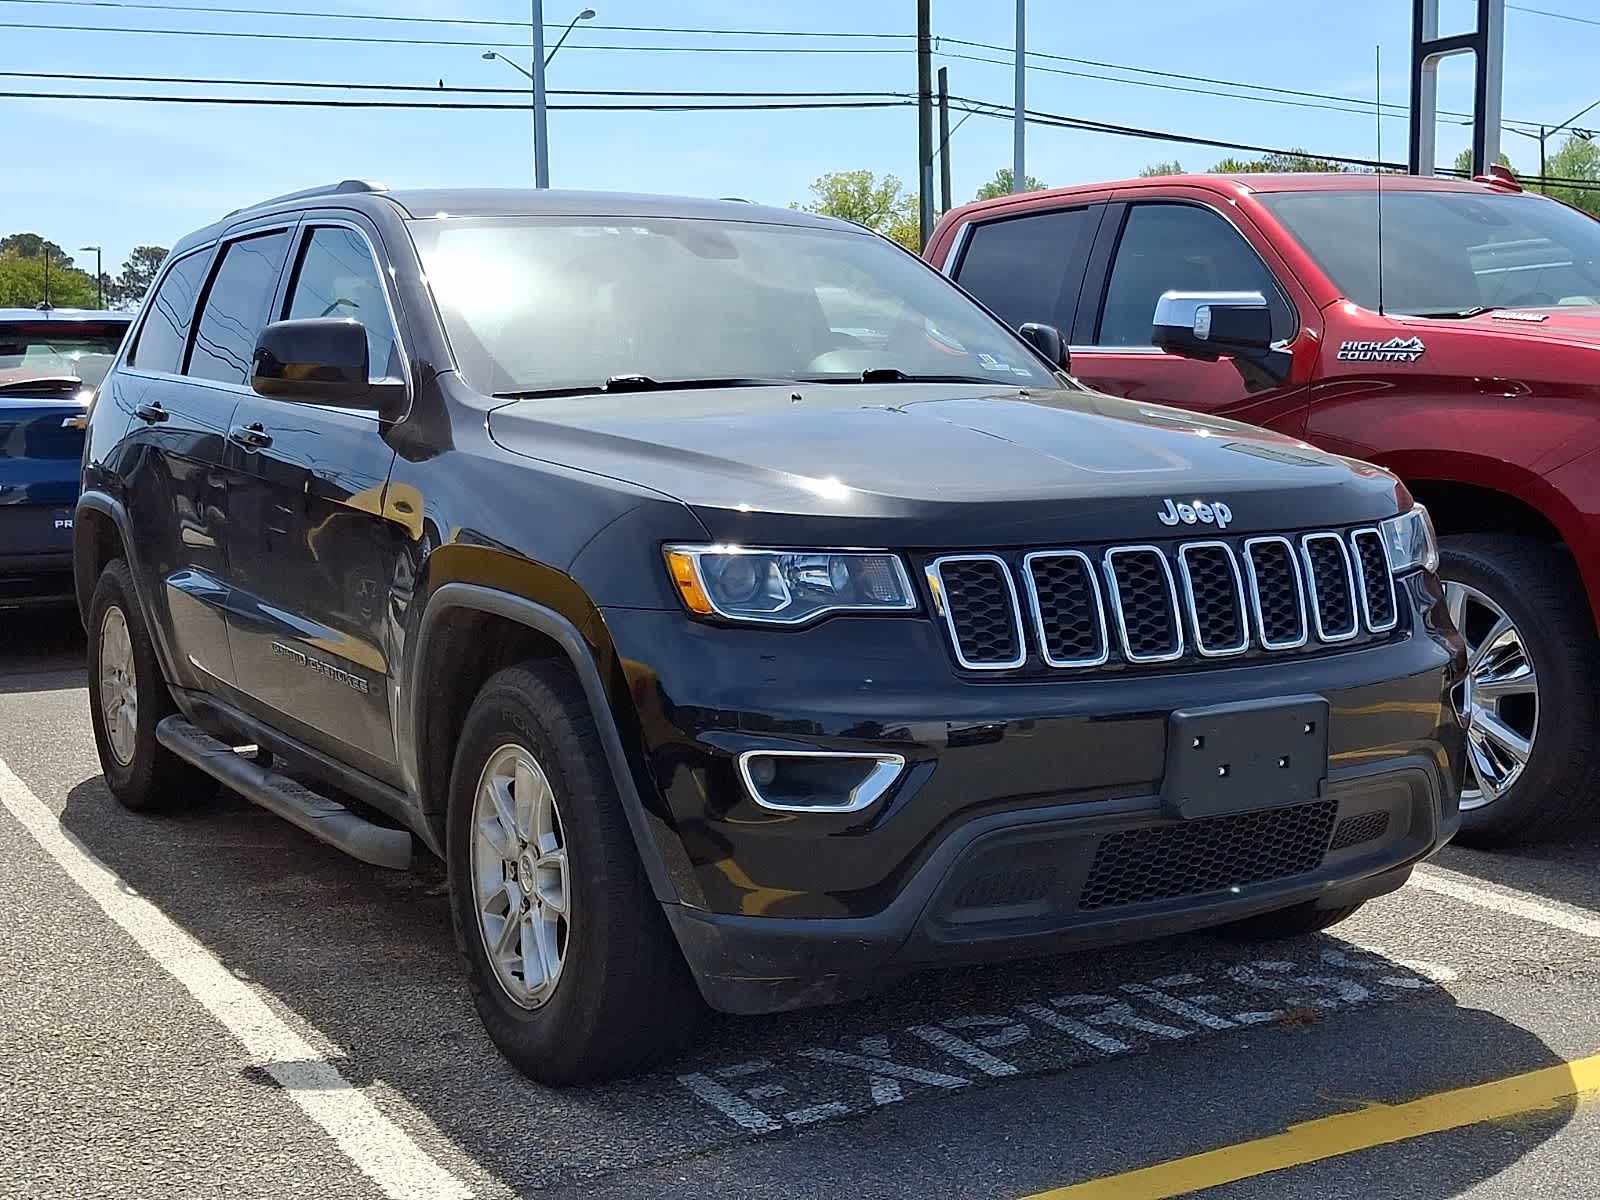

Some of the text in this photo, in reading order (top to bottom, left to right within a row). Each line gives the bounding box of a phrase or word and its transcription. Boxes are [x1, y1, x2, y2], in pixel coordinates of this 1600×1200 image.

[1340, 341, 1381, 351] HIGH
[1336, 351, 1422, 362] COUNTRY
[1157, 498, 1233, 529] Jeep
